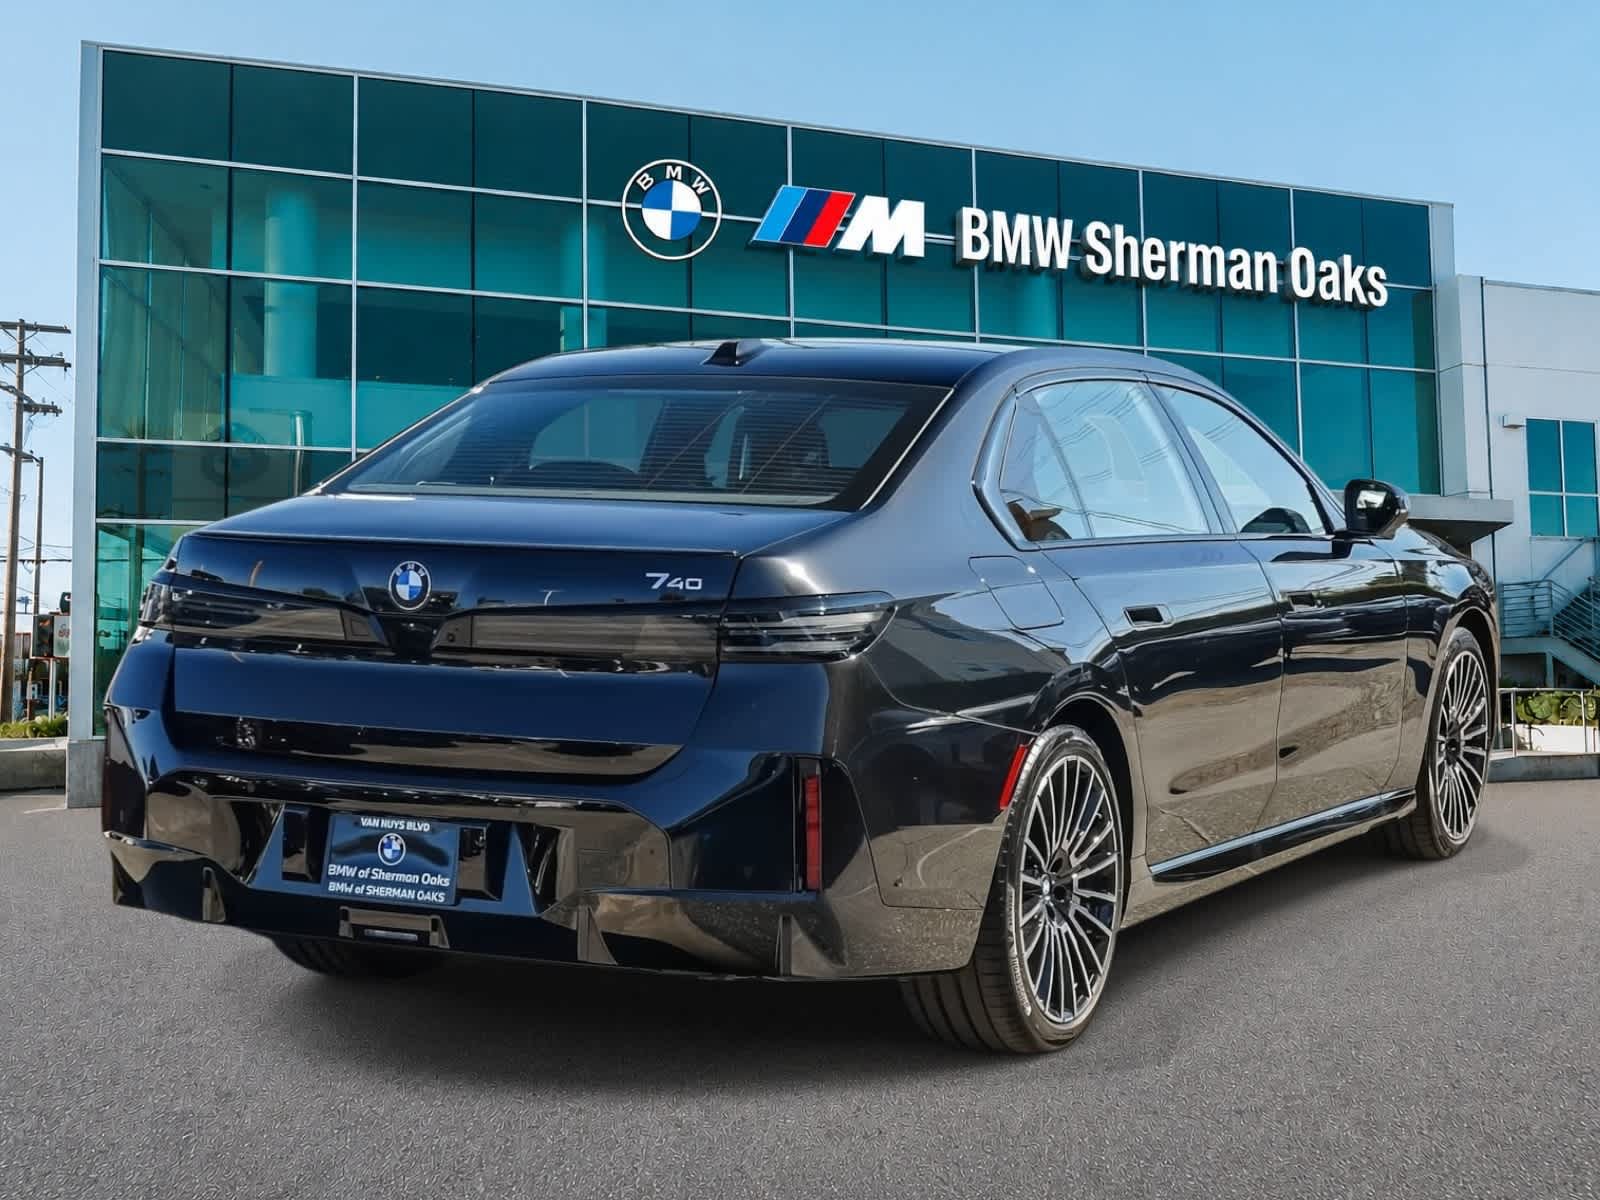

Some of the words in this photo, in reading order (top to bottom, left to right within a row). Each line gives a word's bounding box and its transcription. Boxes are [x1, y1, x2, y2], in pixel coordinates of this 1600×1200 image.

[636, 165, 711, 195] BMW
[961, 206, 1073, 270] BMW
[1085, 220, 1278, 293] Sherman
[1289, 246, 1388, 307] Oaks
[645, 572, 703, 590] 740
[361, 817, 379, 827] VAN
[381, 818, 405, 830] NUYS
[406, 821, 430, 832] BLVD
[328, 864, 357, 878] BMW
[358, 867, 370, 878] of
[371, 868, 419, 884] Sherman
[421, 873, 450, 887] Oaks
[328, 882, 352, 893] BMW
[354, 884, 365, 894] of
[366, 885, 415, 899] SHERMAN
[417, 890, 446, 903] OAKS
